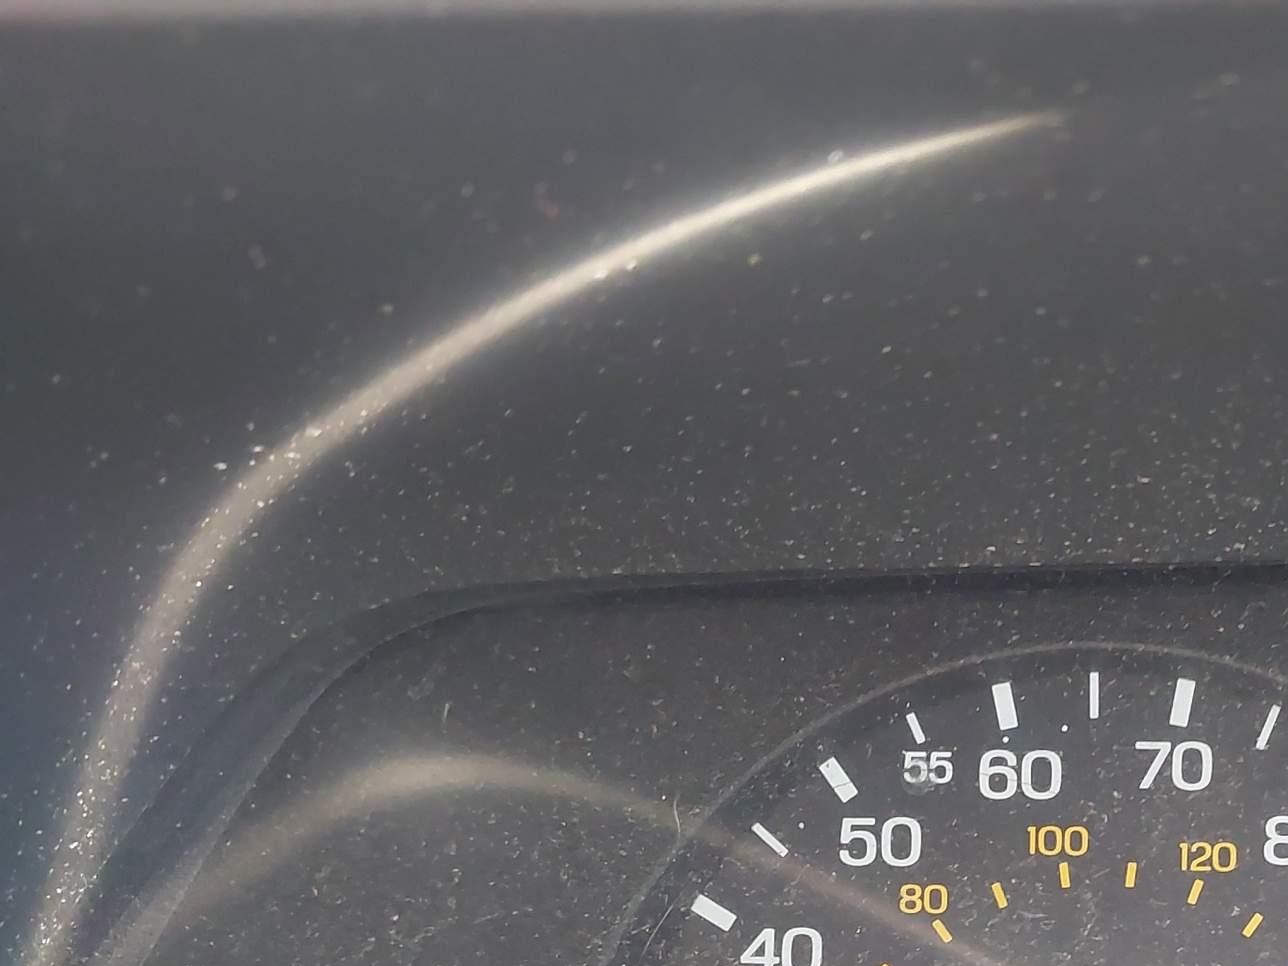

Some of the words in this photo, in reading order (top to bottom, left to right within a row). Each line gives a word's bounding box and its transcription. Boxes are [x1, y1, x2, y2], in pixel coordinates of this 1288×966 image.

[901, 750, 955, 786] 55
[977, 749, 1062, 800] 60
[1133, 740, 1213, 791] 70
[837, 817, 922, 867] 50
[1027, 825, 1090, 857] 100
[1178, 842, 1238, 873] 120
[898, 884, 949, 915] 80
